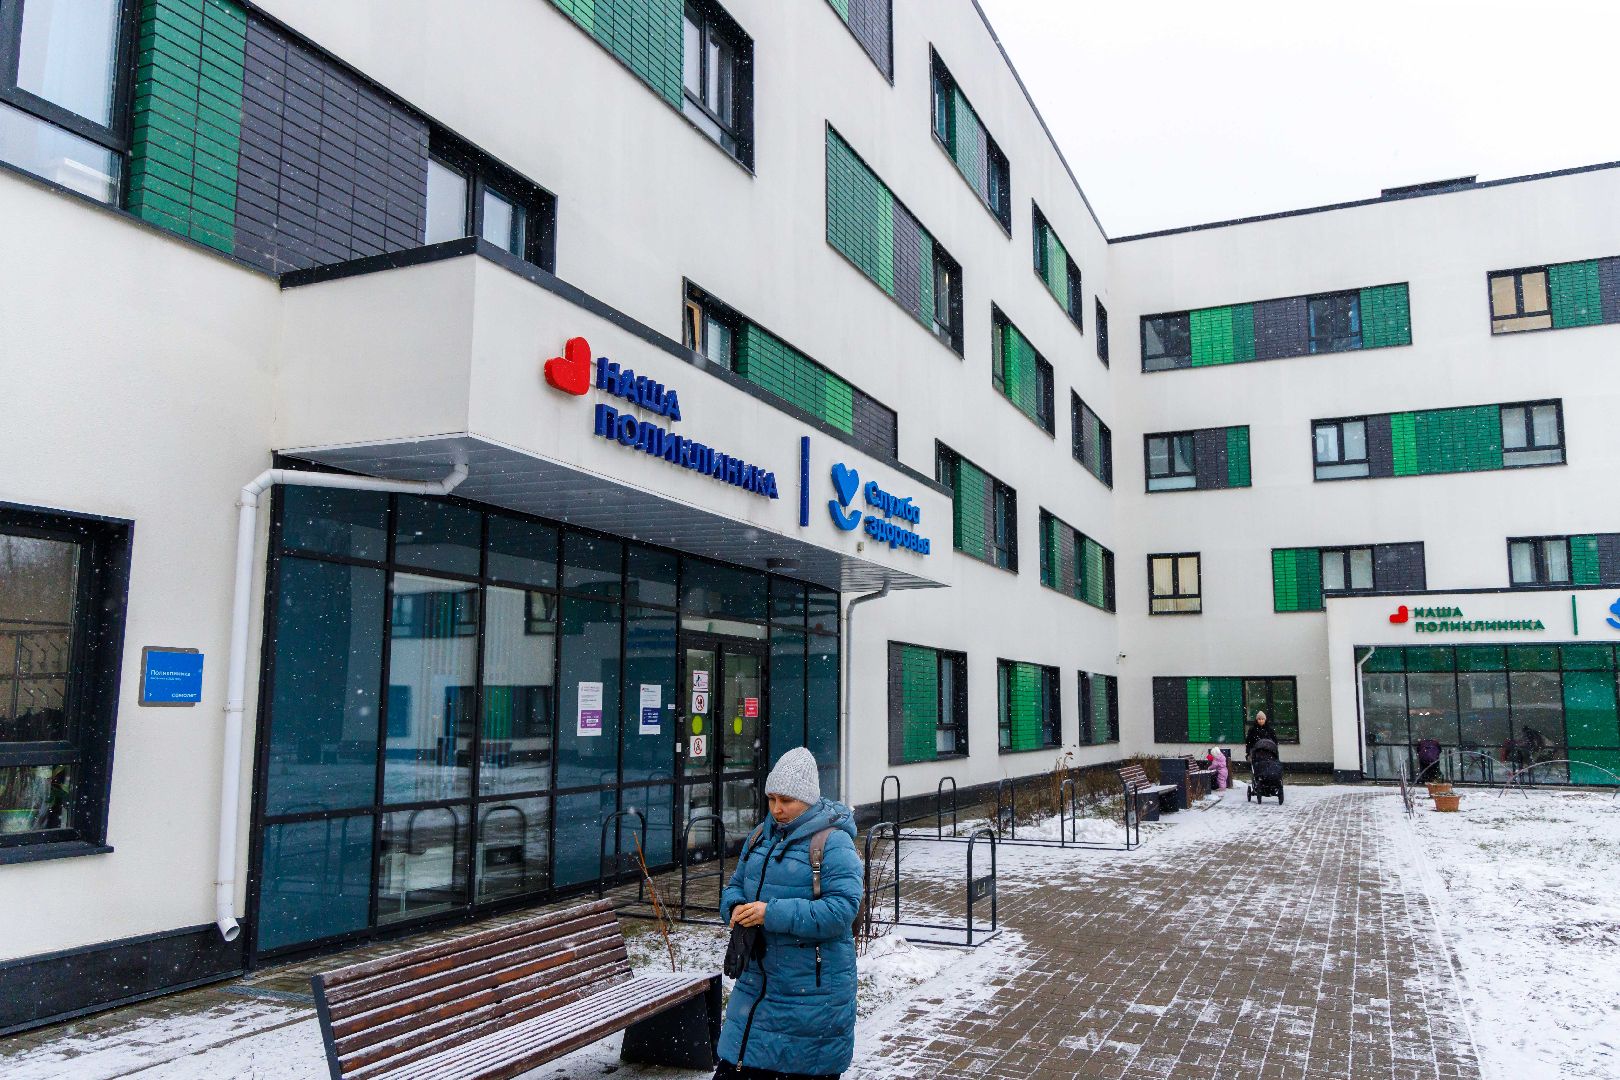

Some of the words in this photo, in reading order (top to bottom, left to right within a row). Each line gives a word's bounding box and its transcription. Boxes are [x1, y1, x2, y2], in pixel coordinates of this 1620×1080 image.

[596, 357, 681, 421] НАША
[594, 403, 779, 499] ПОЛИКЛИНИКА
[864, 481, 920, 524] Служба
[864, 516, 930, 554] здоровья
[1414, 607, 1463, 618] НАША
[1415, 619, 1545, 633] ПОЛИКЛИНИКА
